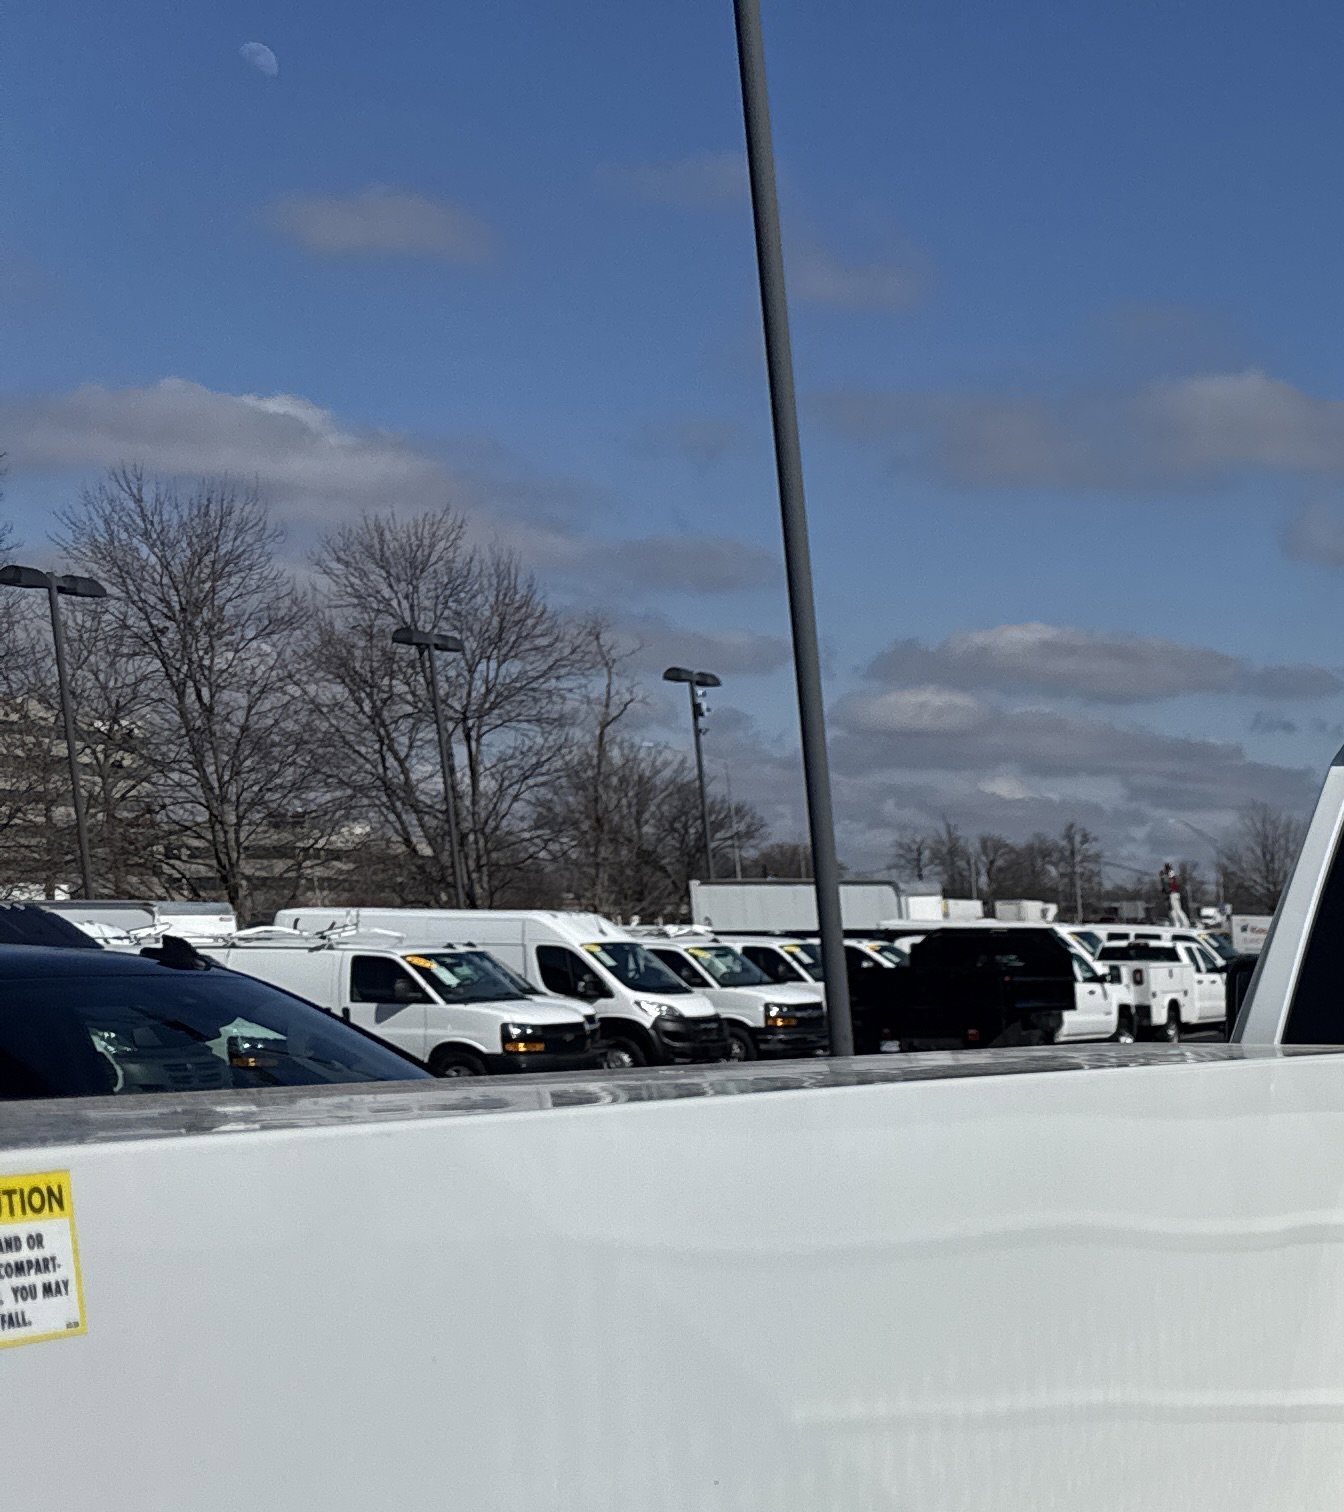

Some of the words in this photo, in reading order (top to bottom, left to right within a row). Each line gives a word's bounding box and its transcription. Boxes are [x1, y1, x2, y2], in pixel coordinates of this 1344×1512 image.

[0, 1184, 65, 1218] TION
[26, 1232, 45, 1250] OR
[11, 1283, 37, 1303] YOU
[42, 1279, 69, 1299] MAY
